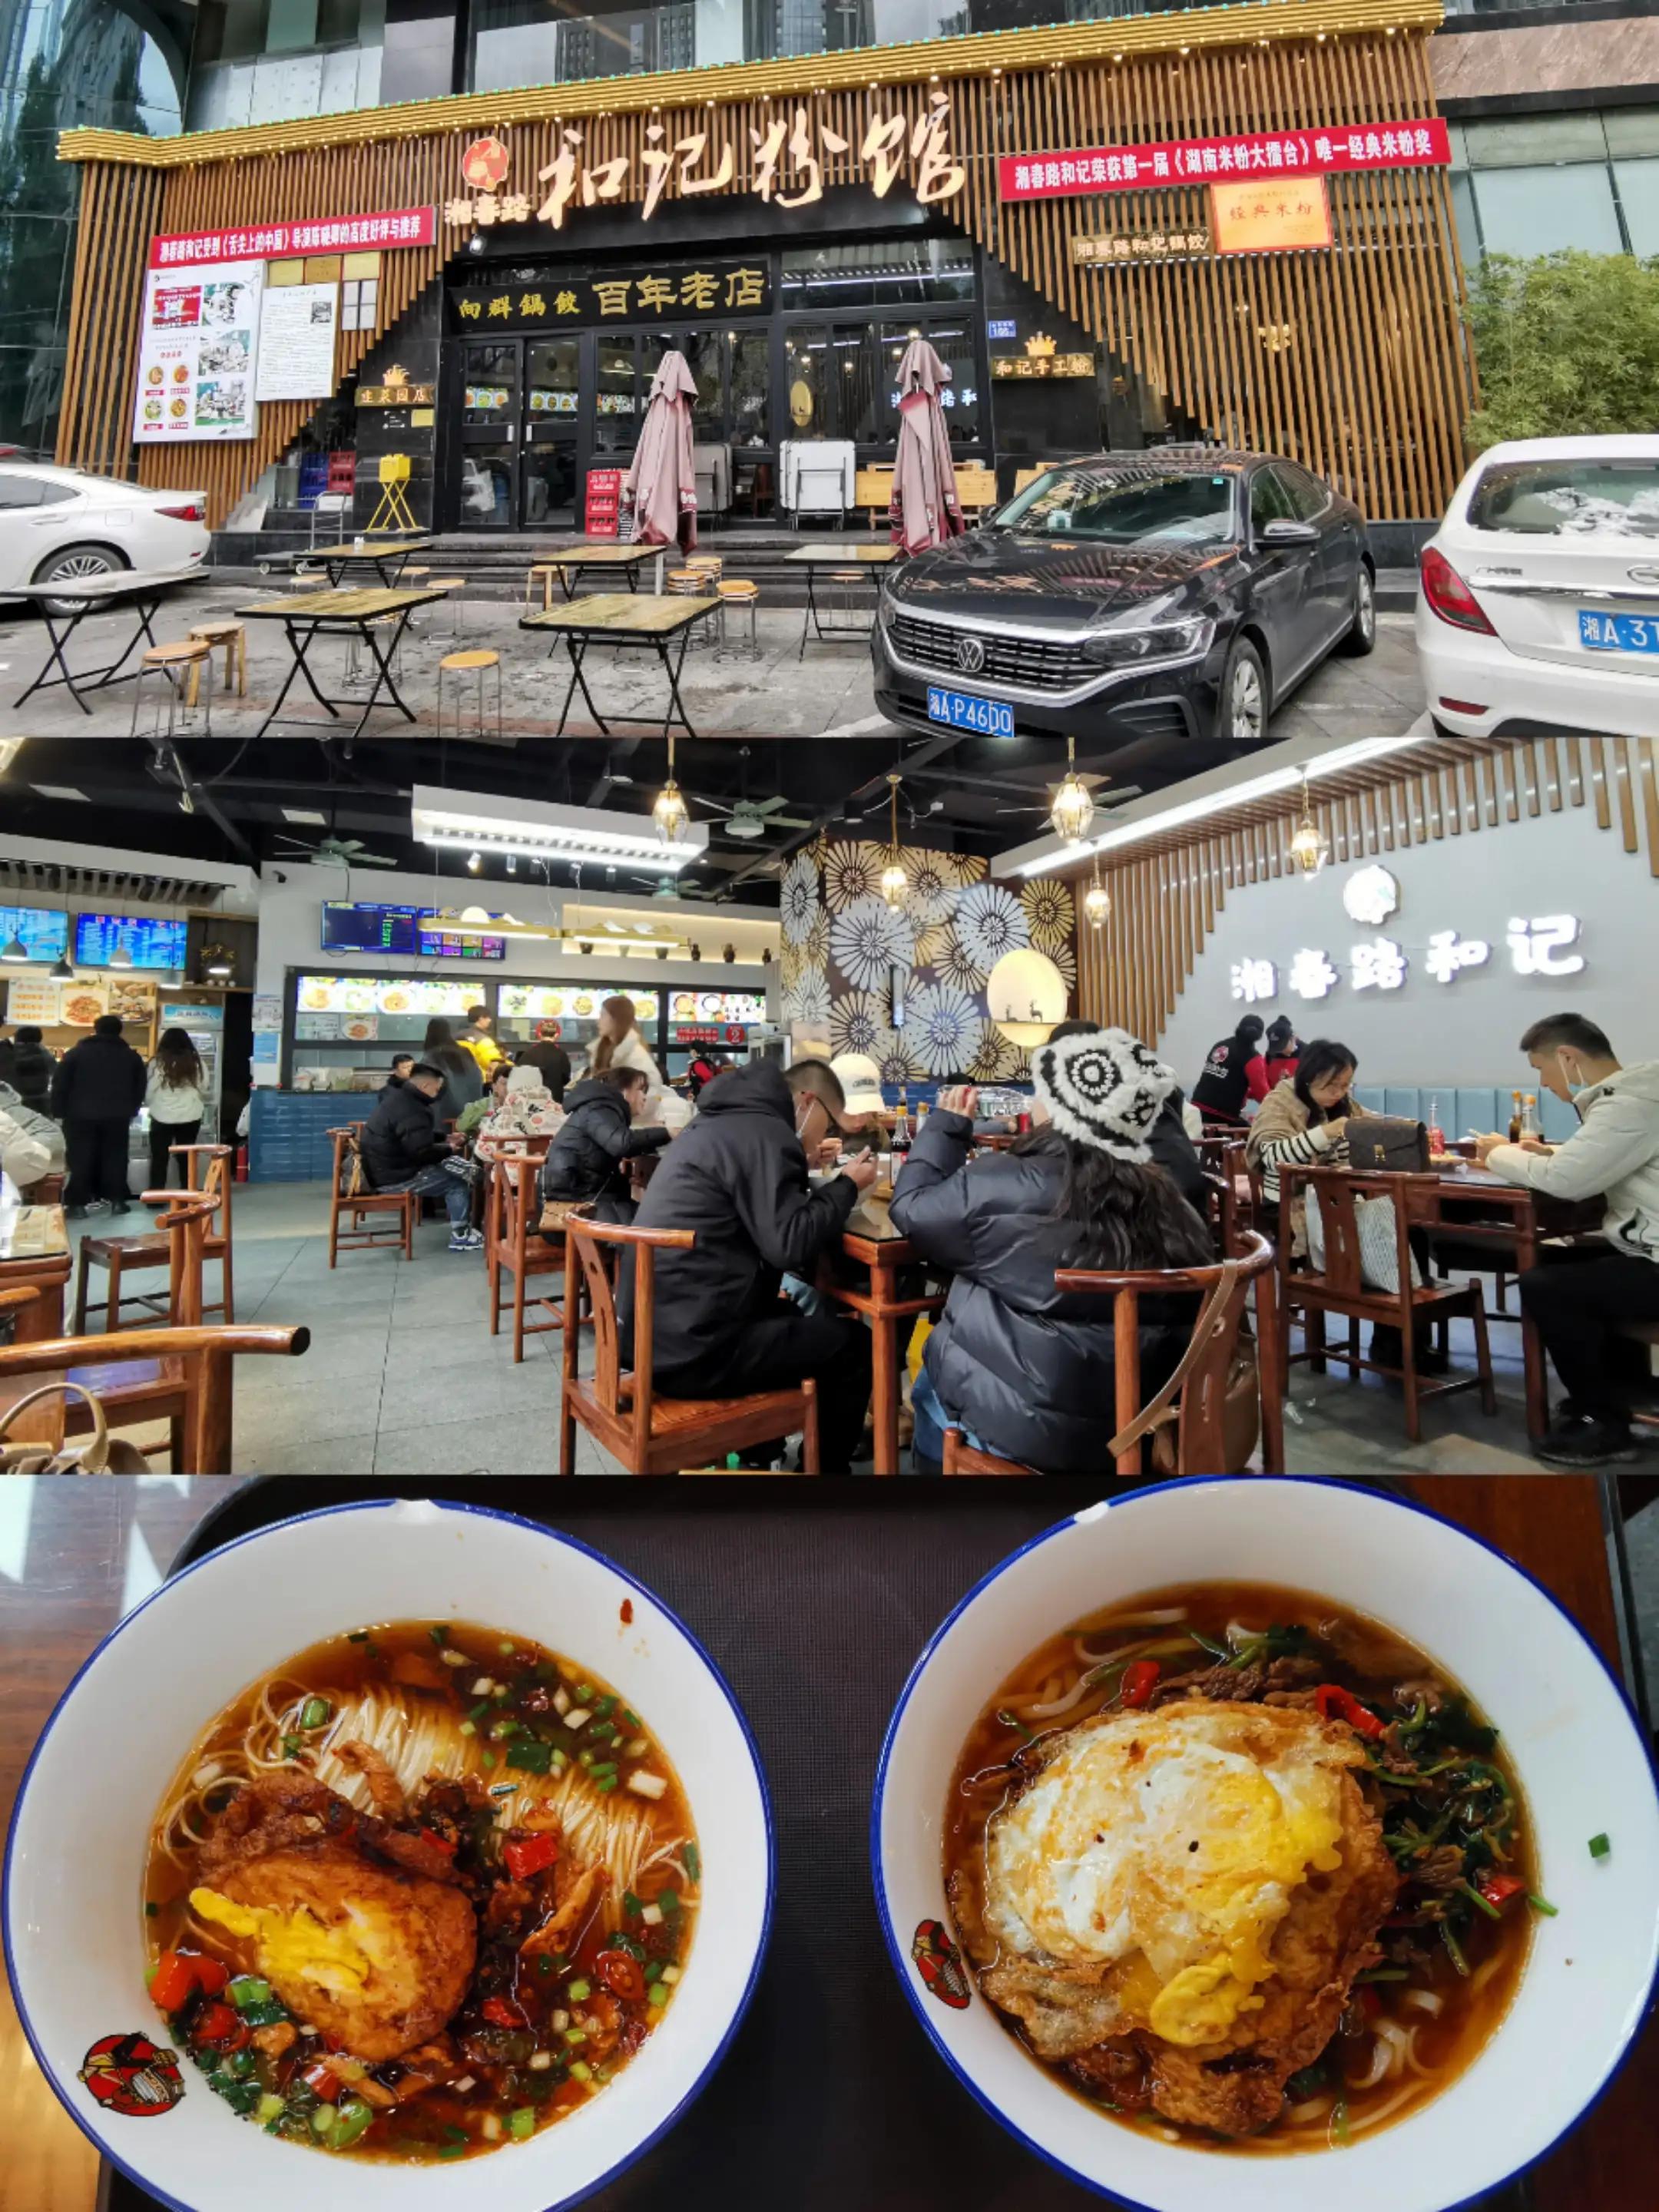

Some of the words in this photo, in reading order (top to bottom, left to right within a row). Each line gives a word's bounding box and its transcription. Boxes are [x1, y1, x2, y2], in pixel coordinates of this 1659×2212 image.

[538, 91, 966, 229] 和记粉馆
[445, 192, 531, 226] 湘春路
[592, 267, 765, 316] 百年老店
[1230, 913, 1589, 1003] 湘春路和记
